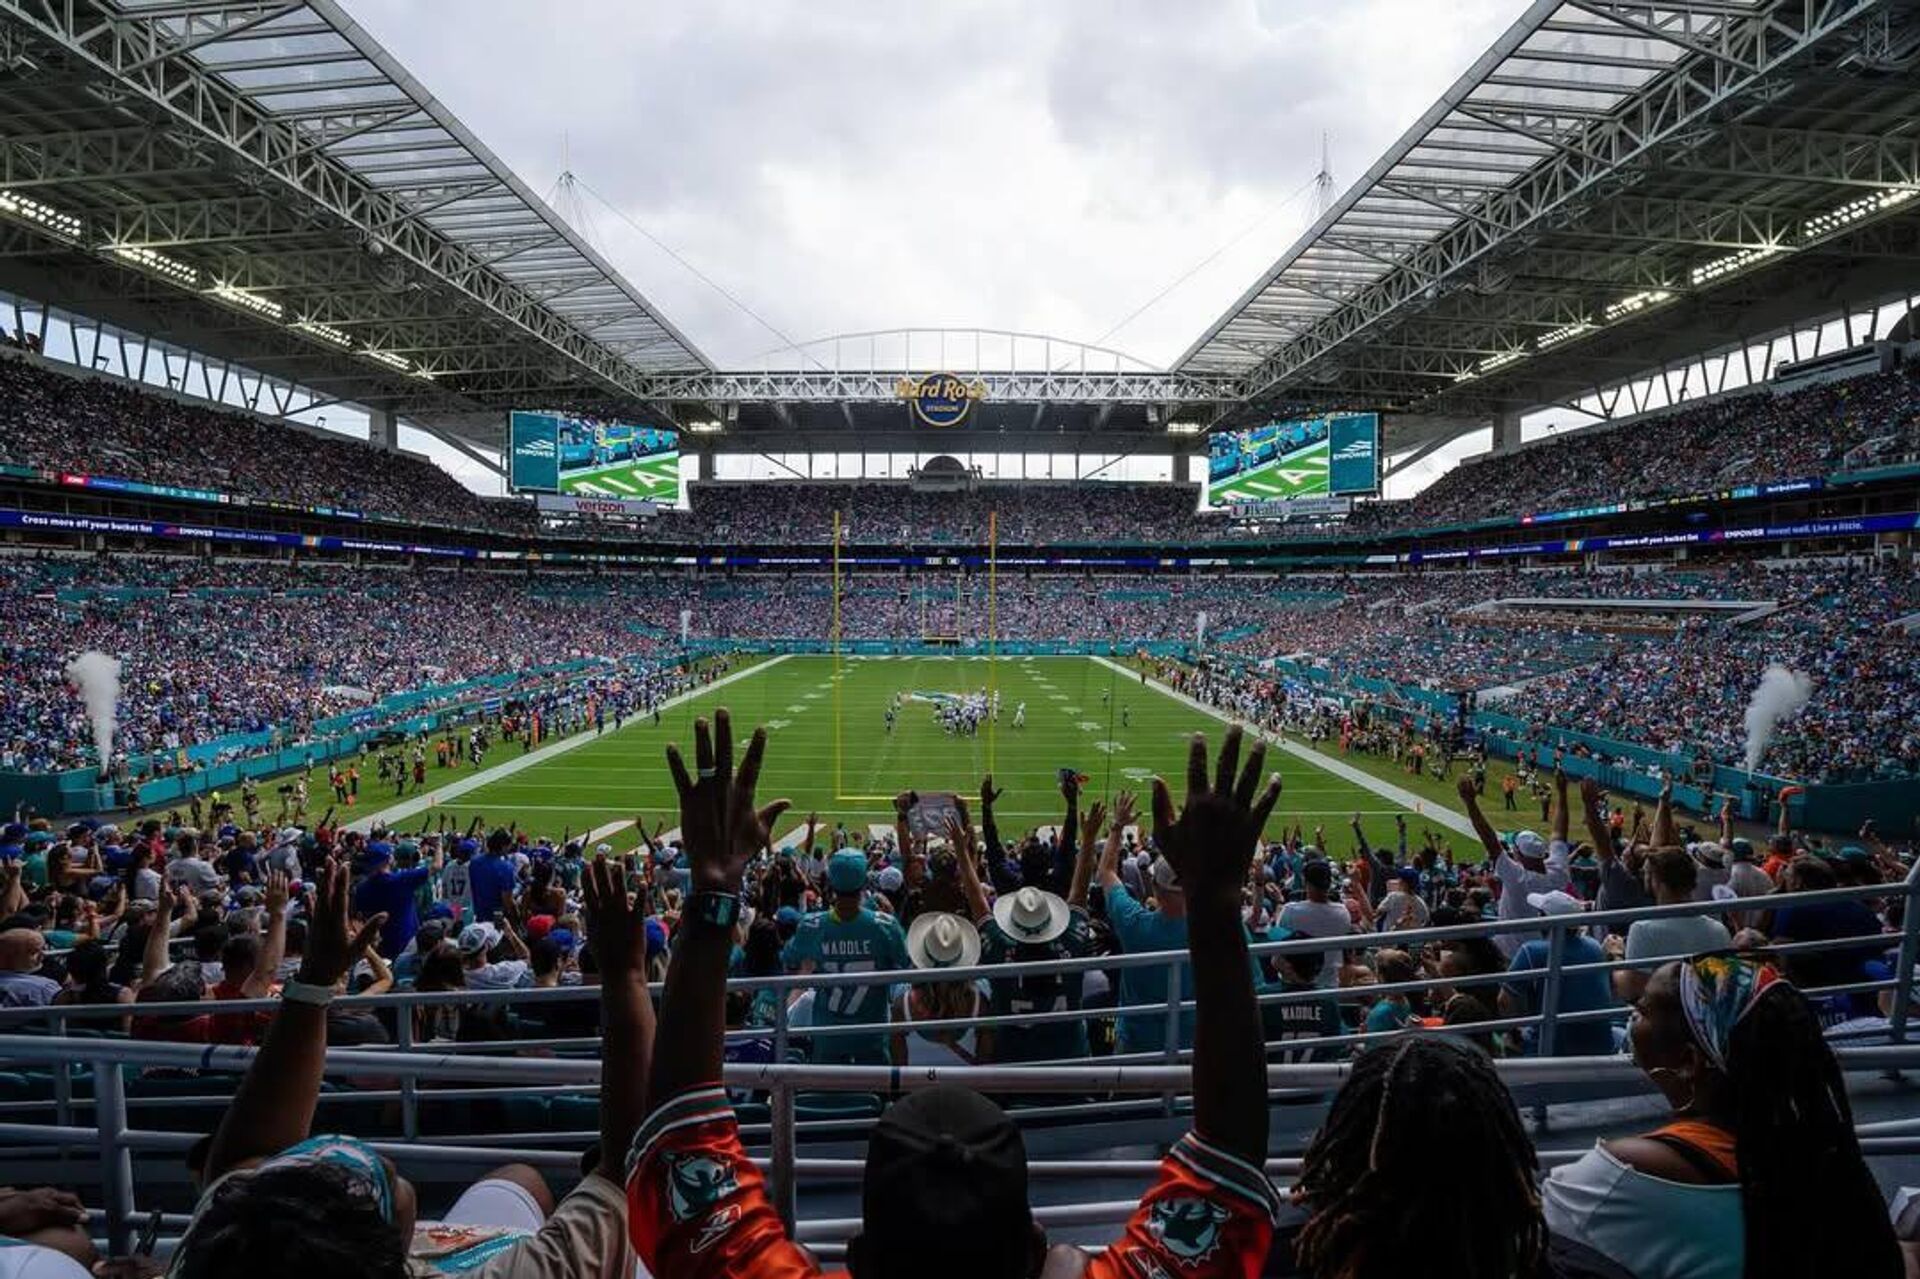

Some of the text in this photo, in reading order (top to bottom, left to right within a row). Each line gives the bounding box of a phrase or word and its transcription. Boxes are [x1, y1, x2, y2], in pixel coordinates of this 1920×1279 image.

[516, 448, 555, 458] EMPOWER
[1333, 450, 1372, 461] EMPOWER
[575, 500, 626, 514] verizon
[22, 514, 49, 525] Cross
[50, 518, 74, 527] more
[76, 519, 89, 529] off
[90, 522, 109, 531] your
[179, 526, 214, 537] EMPOWER
[1724, 528, 1764, 539] EMPOWER
[821, 940, 872, 955] WADDLE
[1281, 1006, 1322, 1020] WADDLE
